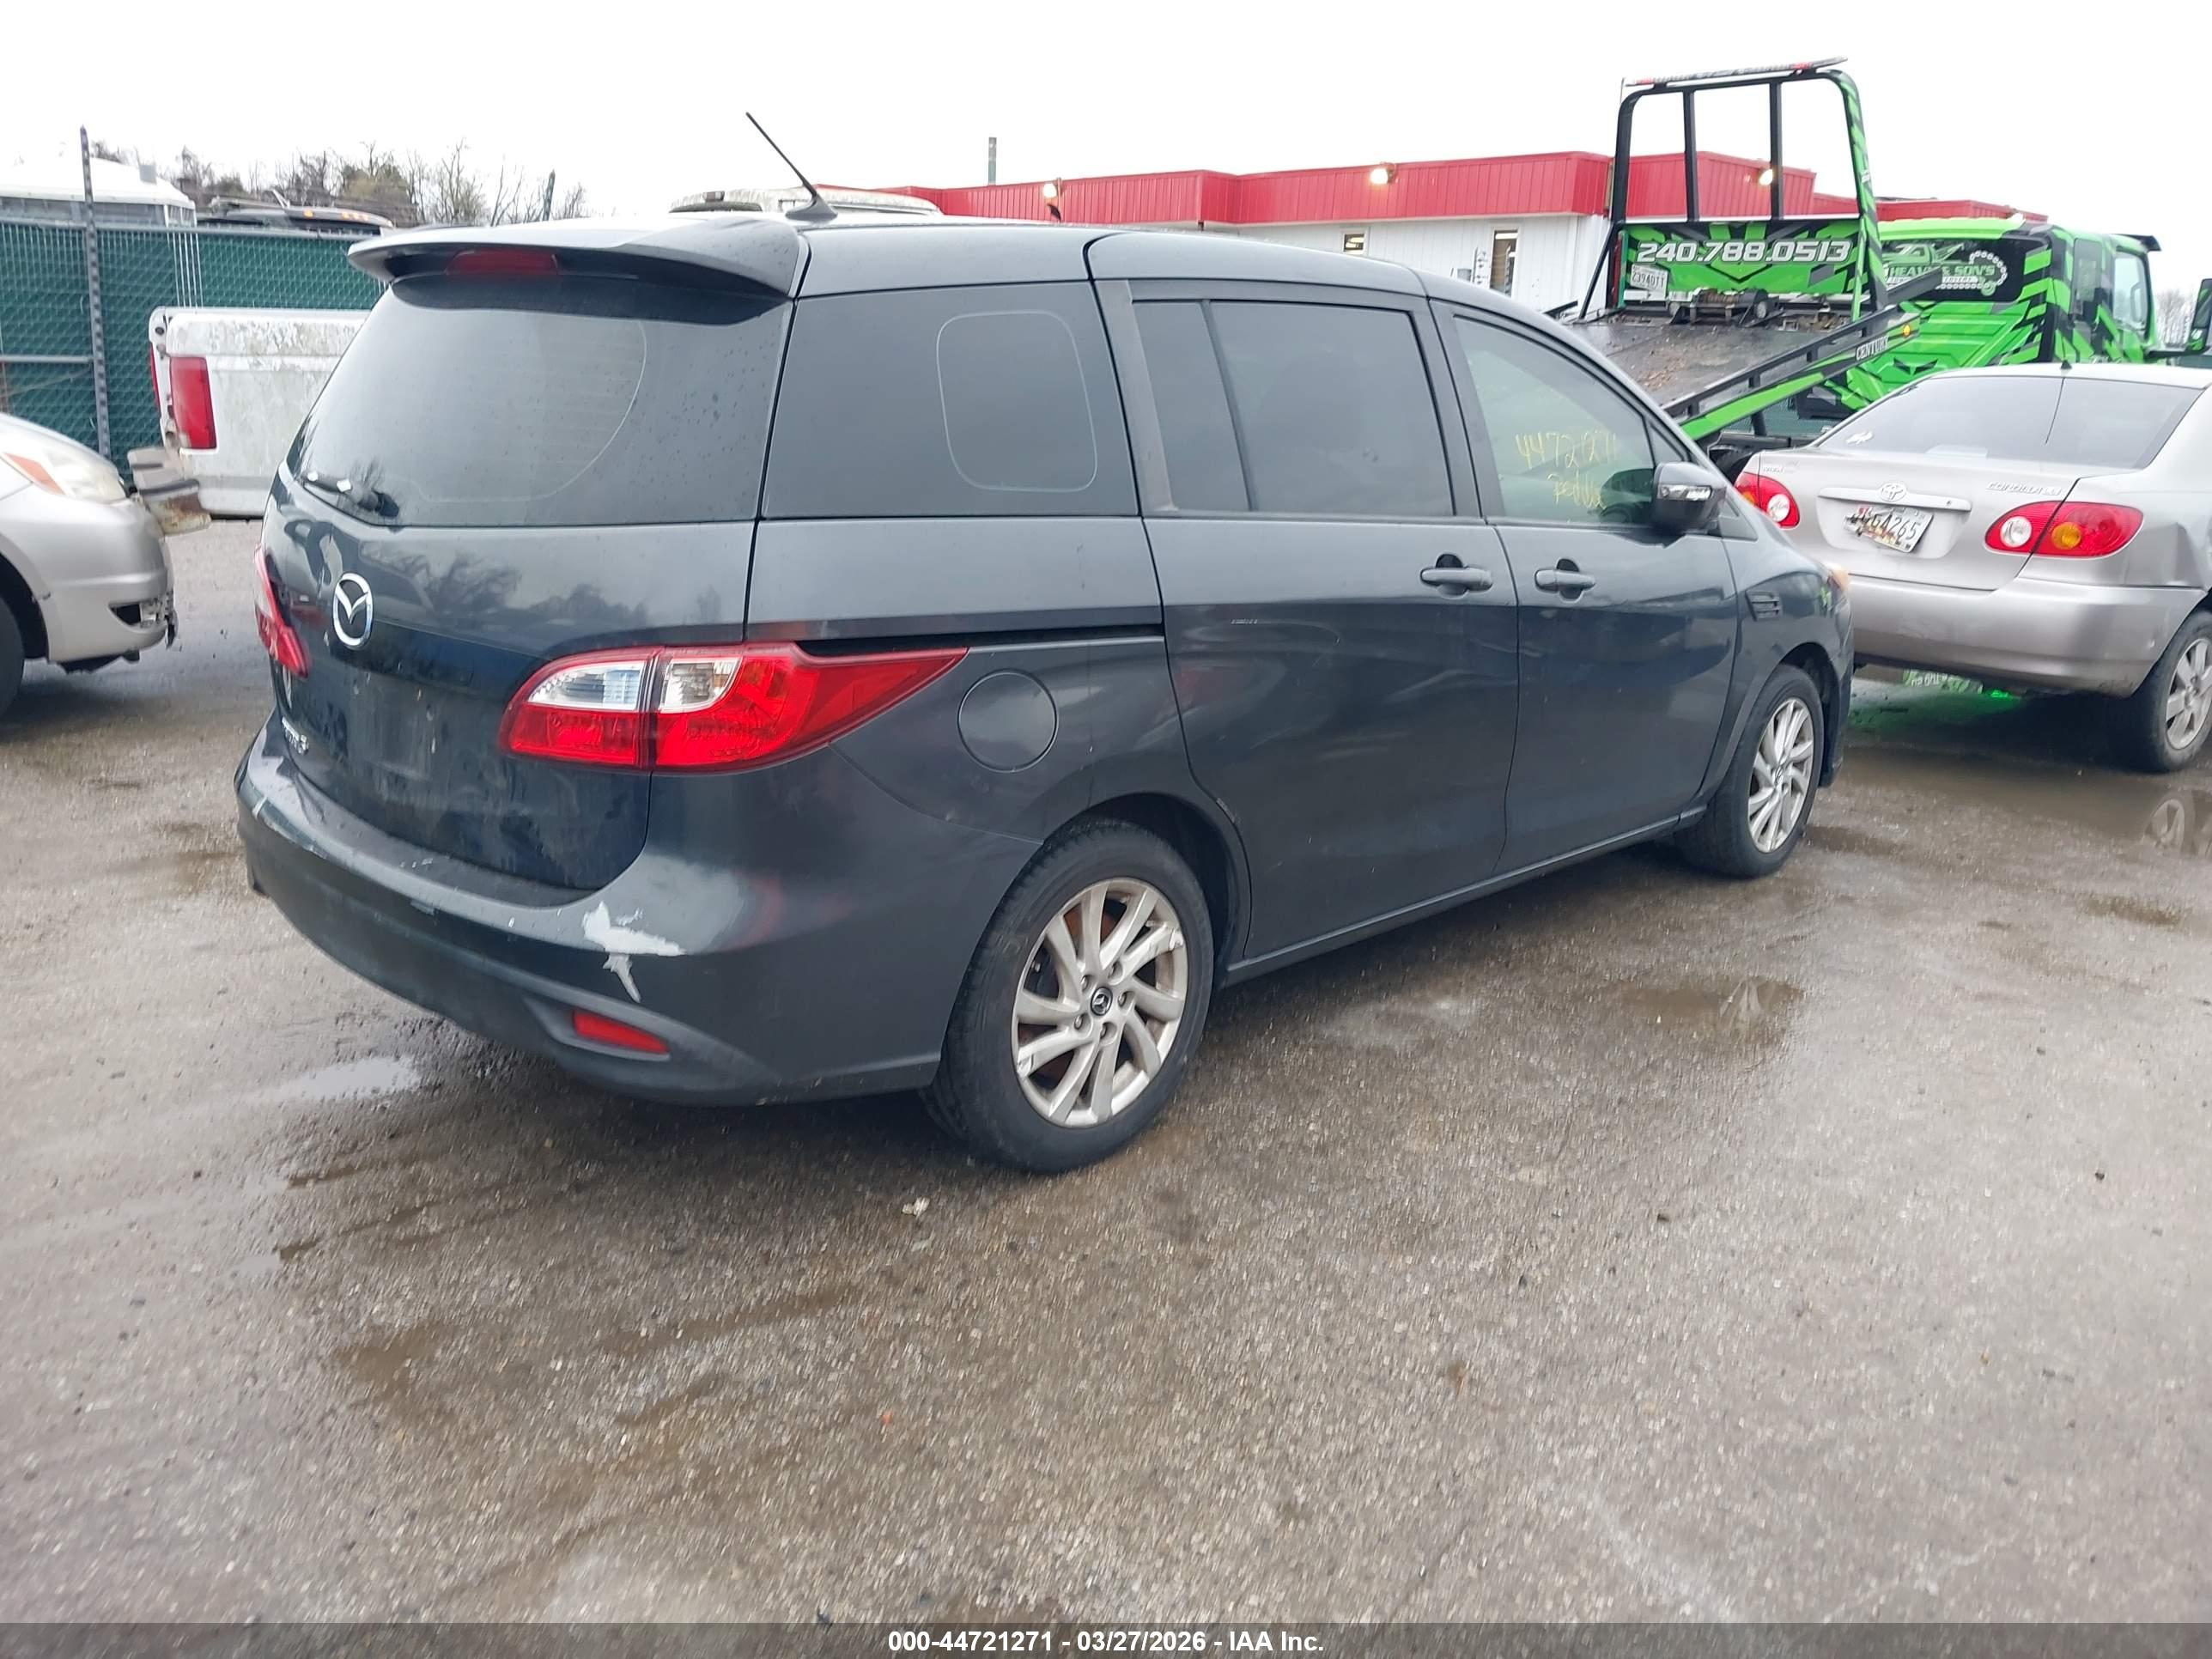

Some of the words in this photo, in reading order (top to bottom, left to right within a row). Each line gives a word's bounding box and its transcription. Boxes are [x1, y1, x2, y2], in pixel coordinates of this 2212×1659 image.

[1637, 240, 1851, 262] 240.788.0513
[1942, 265, 1951, 276] &
[1954, 265, 1996, 276] SON'S
[1856, 336, 1888, 361] CENTURY
